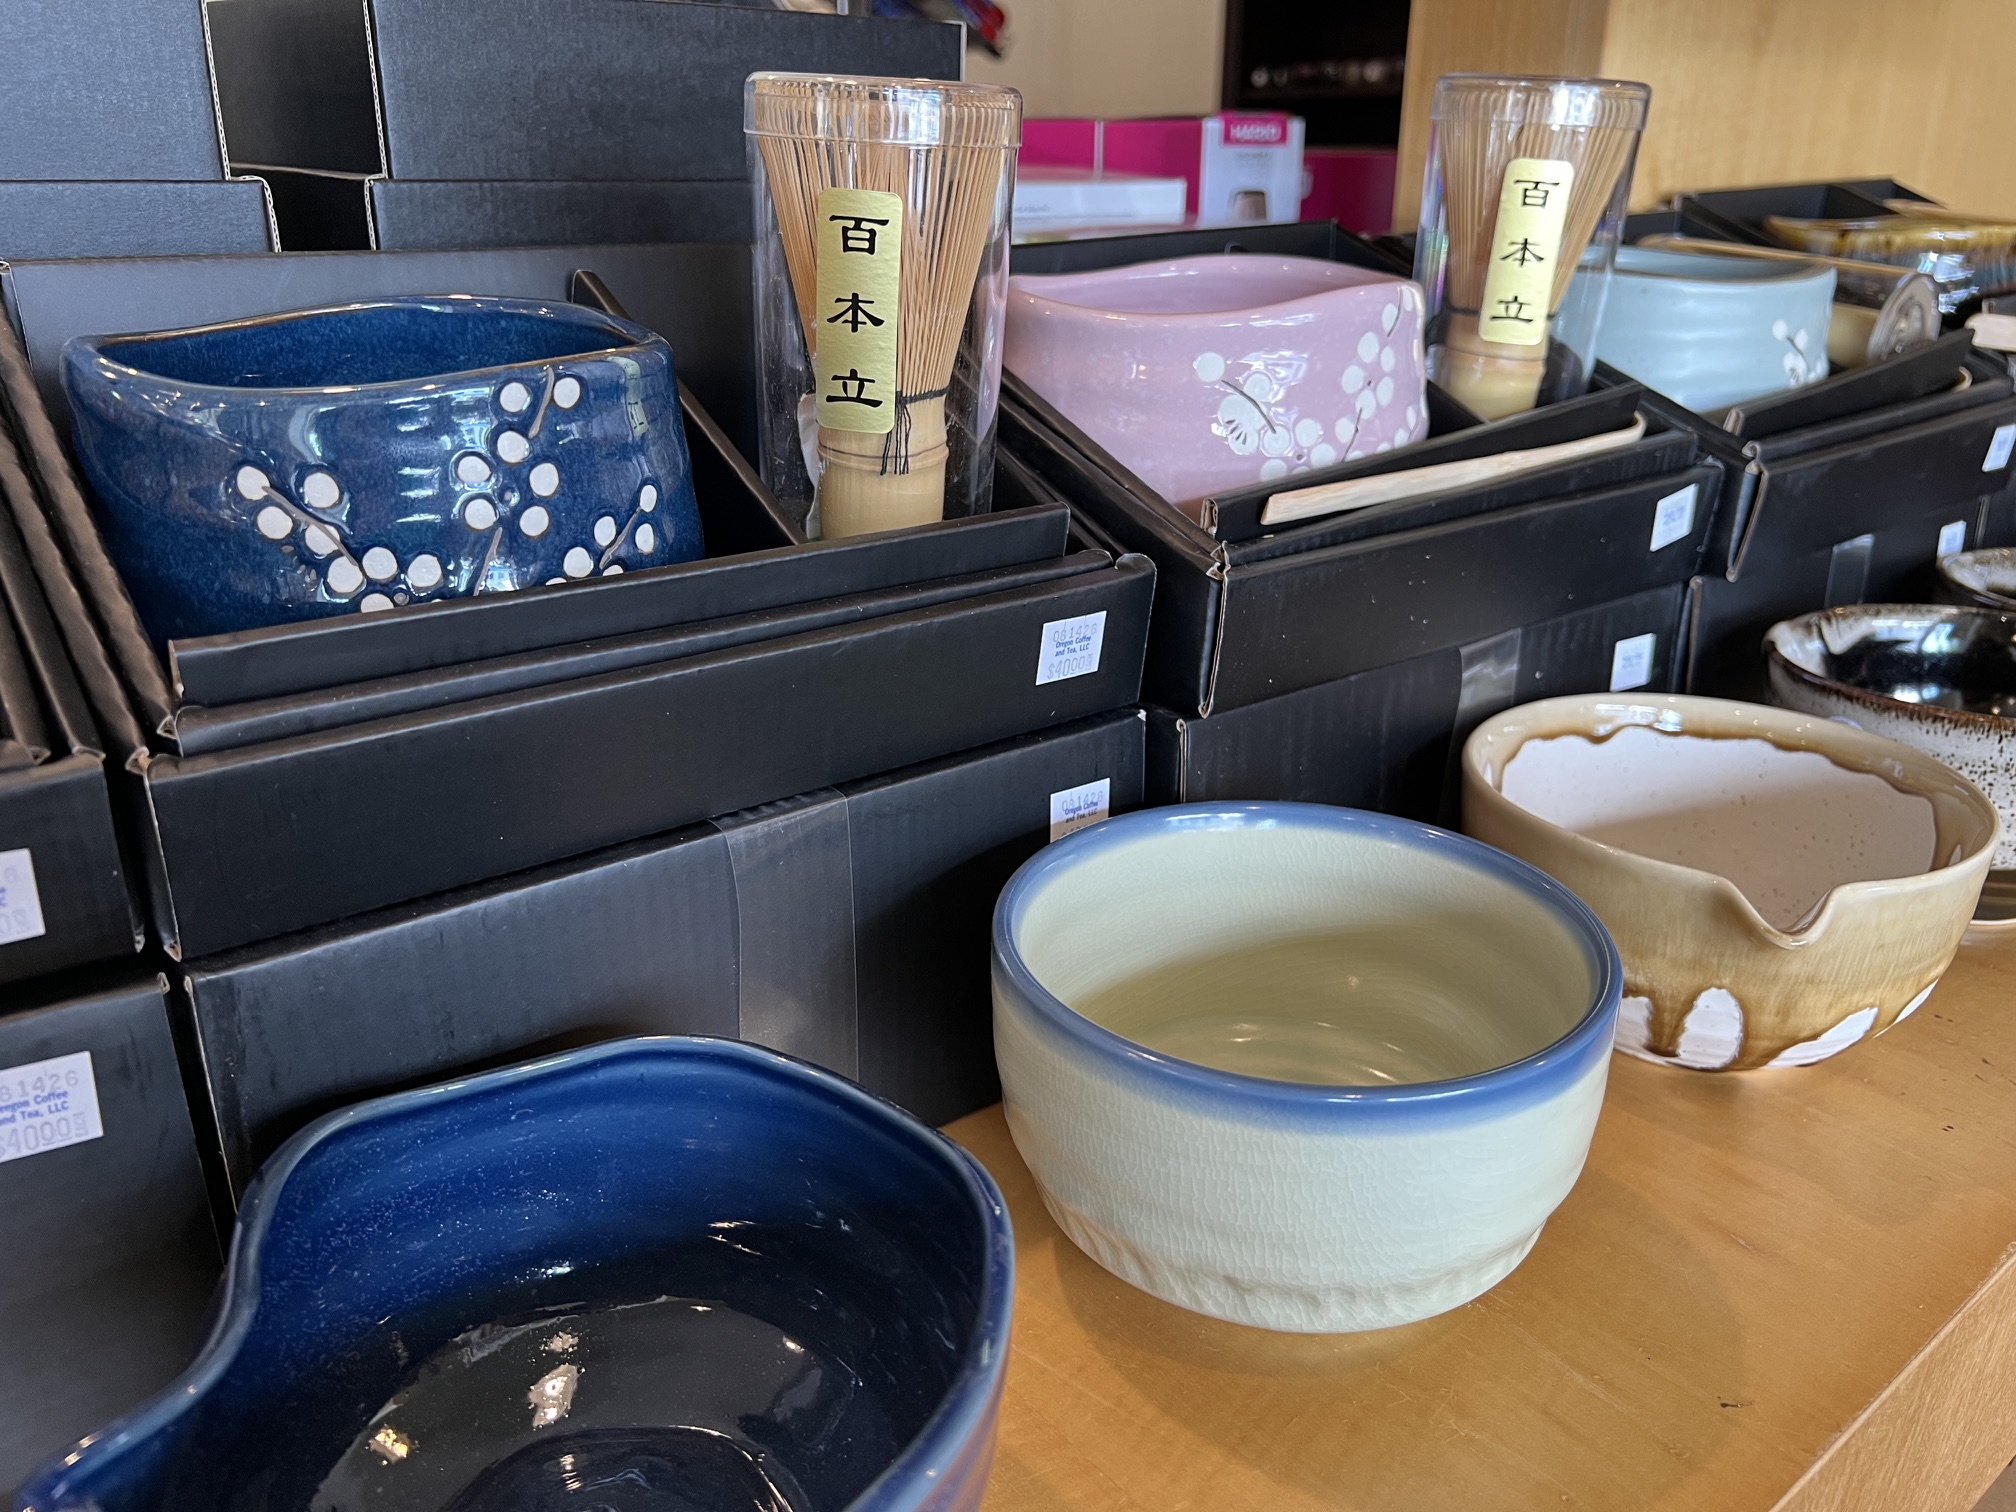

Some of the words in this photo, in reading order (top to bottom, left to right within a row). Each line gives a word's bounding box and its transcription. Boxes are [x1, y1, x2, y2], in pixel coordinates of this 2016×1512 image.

[1490, 179, 1560, 324] 百本立
[826, 214, 890, 408] 百本立
[1052, 623, 1098, 643] 081426
[1055, 640, 1074, 649] Oregon
[1075, 636, 1091, 645] Coffee
[1055, 648, 1065, 657] and
[1080, 643, 1090, 652] LLC
[1064, 805, 1082, 815] Oregon
[1083, 800, 1098, 810] Coffee
[0, 1070, 79, 1102] 81426
[0, 1100, 30, 1112] regon
[34, 1090, 68, 1105] Coffee
[20, 1110, 44, 1120] Tea,
[48, 1101, 69, 1114] LLC
